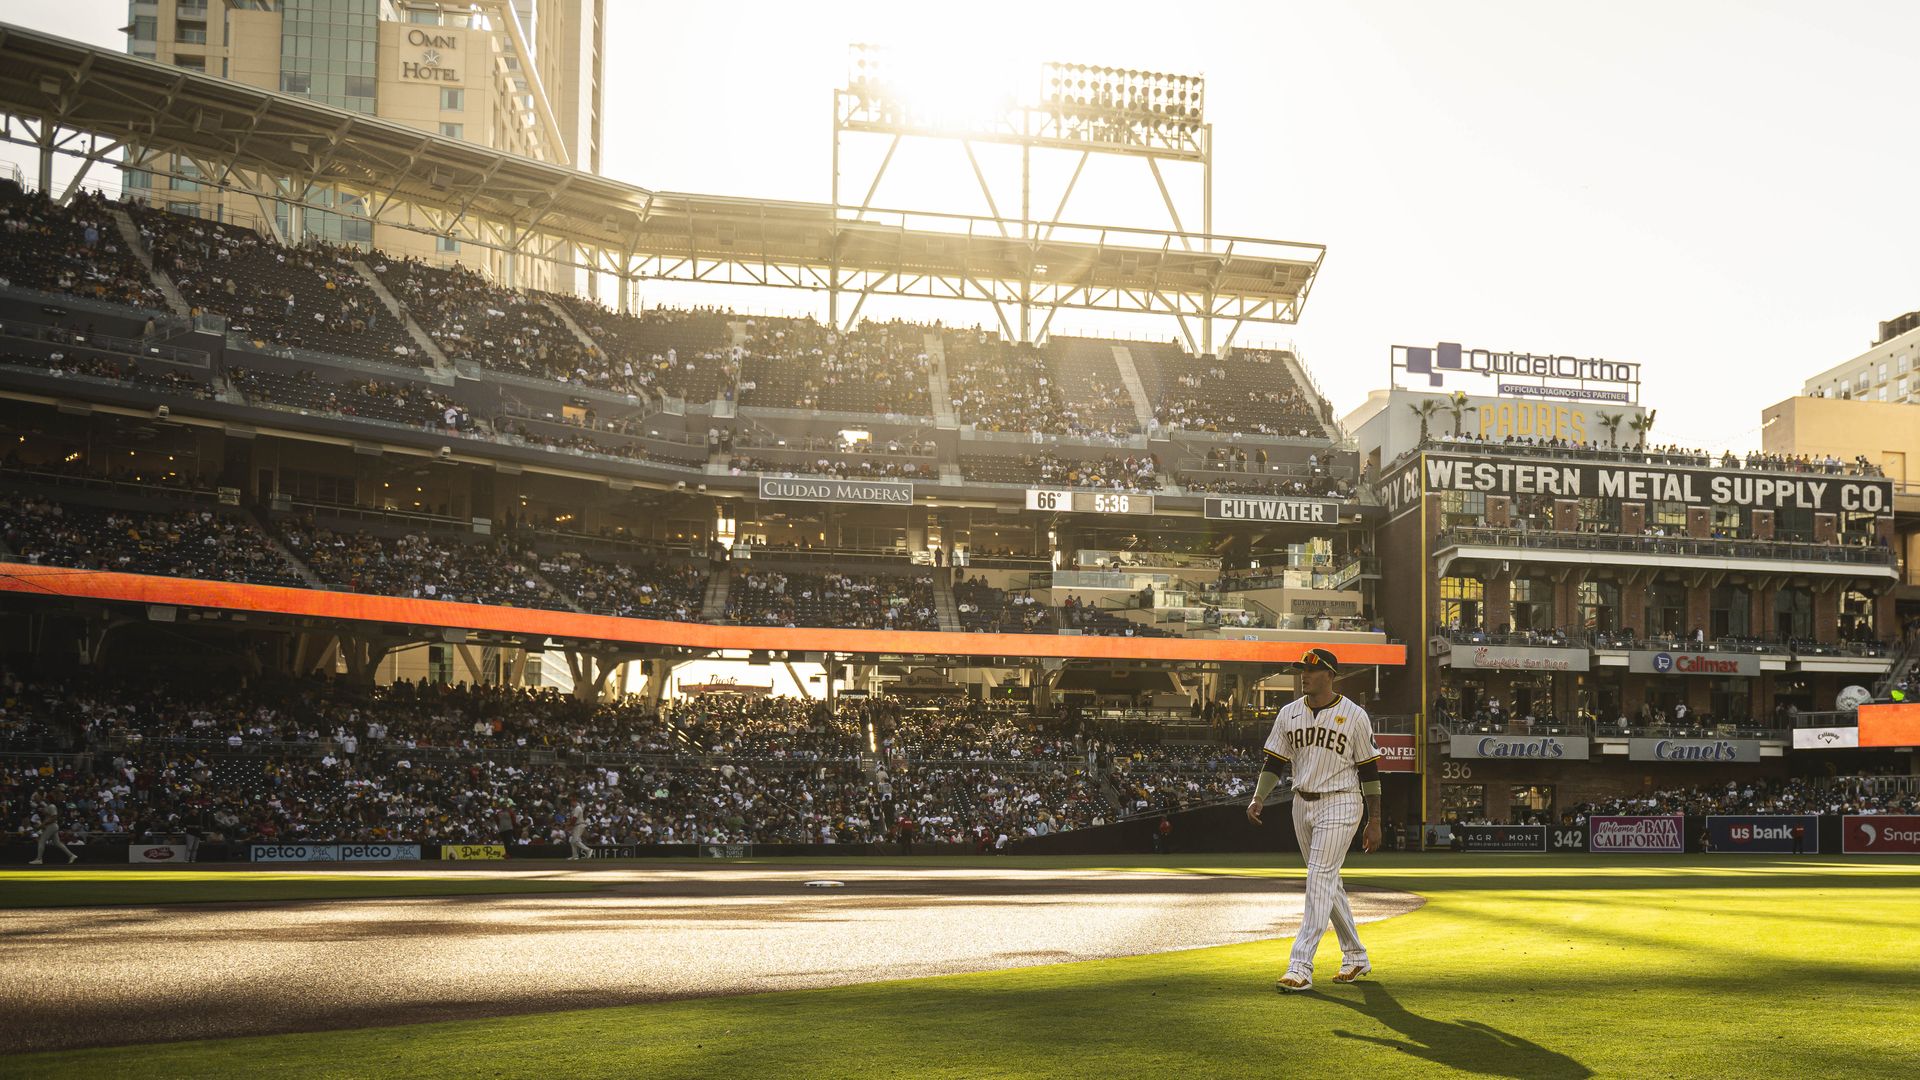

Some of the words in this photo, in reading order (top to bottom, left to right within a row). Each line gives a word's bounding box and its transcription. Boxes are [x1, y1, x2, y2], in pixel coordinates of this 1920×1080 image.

[408, 29, 456, 49] OMNI
[403, 61, 460, 81] HOTEL
[1470, 349, 1630, 381] QuidelOrtho
[1503, 385, 1538, 394] OFFICIAL
[1540, 388, 1590, 398] DIAGNOSTICS
[1592, 391, 1626, 401] PARTNER
[1480, 403, 1585, 445] PADRES
[764, 482, 831, 498] CIUDAD
[836, 485, 909, 501] MADERAS
[1381, 477, 1400, 512] PLY
[1427, 459, 1580, 495] WESTERN
[1599, 470, 1701, 502] METAL
[1711, 476, 1827, 509] SUPPLY
[1841, 484, 1890, 512] CO.
[1095, 494, 1129, 512] 5:36
[1220, 500, 1323, 522] CUTWATER
[1286, 726, 1347, 755] PADRES
[1817, 732, 1840, 741] Callaway
[1379, 746, 1395, 756] ON
[1477, 737, 1564, 759] Canel's
[1654, 739, 1737, 761] Canel's
[1442, 762, 1471, 779] 336
[1644, 820, 1676, 834] BAJA
[1731, 827, 1749, 839] us
[1753, 825, 1793, 839] bank
[1554, 831, 1582, 848] 342
[1595, 833, 1679, 847] CALIFORNIA
[254, 845, 306, 861] petco
[342, 844, 391, 860] petco
